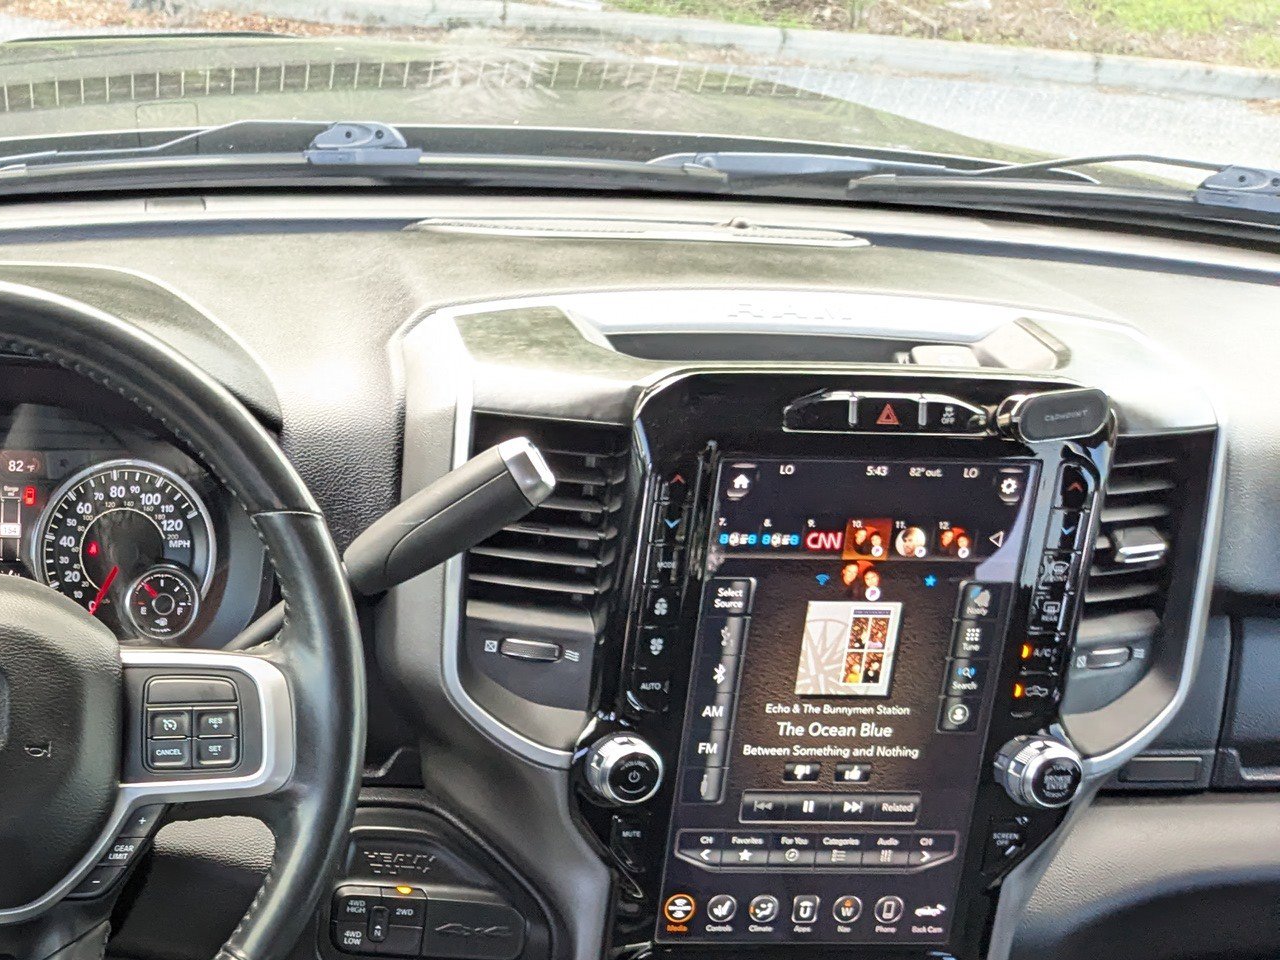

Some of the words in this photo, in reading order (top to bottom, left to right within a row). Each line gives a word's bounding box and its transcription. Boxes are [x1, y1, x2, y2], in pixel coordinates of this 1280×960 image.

[940, 416, 955, 425] OFF
[8, 460, 24, 472] 82
[779, 465, 795, 475] LO
[866, 466, 888, 477] 5:43
[963, 467, 979, 478] LO
[110, 485, 126, 498] 80
[130, 486, 141, 494] 90
[94, 492, 105, 501] 70
[140, 493, 162, 505] 100
[76, 502, 92, 514] 60
[160, 504, 174, 513] 110
[66, 518, 77, 527] 50
[162, 519, 184, 532] 120
[59, 536, 76, 548] 40
[168, 540, 191, 549] MPH
[807, 532, 843, 549] CNN
[59, 556, 69, 565] 30
[64, 571, 81, 583] 20
[73, 591, 83, 599] 10
[717, 588, 743, 598] Select
[714, 599, 743, 609] Source
[140, 607, 147, 615] E
[177, 607, 183, 615] F
[963, 642, 980, 652] Tune
[640, 682, 661, 691] AUTO
[952, 681, 977, 691] Search
[702, 706, 724, 717] AM
[765, 703, 790, 714] Echo
[793, 704, 801, 714] &
[803, 704, 821, 714] The
[823, 704, 874, 717] Bunnymen
[876, 705, 911, 716] Station
[777, 722, 805, 737] The
[809, 723, 856, 738] Ocean
[859, 723, 893, 738] Blue
[698, 742, 718, 754] FM
[743, 745, 790, 756] Between
[792, 745, 850, 759] Something
[852, 746, 873, 757] and
[876, 746, 919, 759] Nothing
[881, 803, 914, 813] Related
[622, 830, 641, 838] MUTE
[993, 832, 1019, 840] SCREEN
[700, 836, 713, 845] CH
[731, 836, 764, 845] Favorites
[781, 837, 793, 845] For
[794, 837, 809, 845] You
[823, 837, 860, 847] Categories
[877, 837, 899, 846] Audio
[920, 837, 933, 846] CH
[347, 906, 366, 914] HIGH
[395, 907, 414, 916] 2WD
[374, 929, 381, 937] N
[666, 924, 688, 933] Media
[705, 924, 733, 933] Controls
[748, 924, 774, 933] Climate
[793, 925, 812, 934] Apps
[875, 925, 897, 934] Phone
[344, 930, 362, 938] 4WD
[344, 938, 362, 946] LOW
